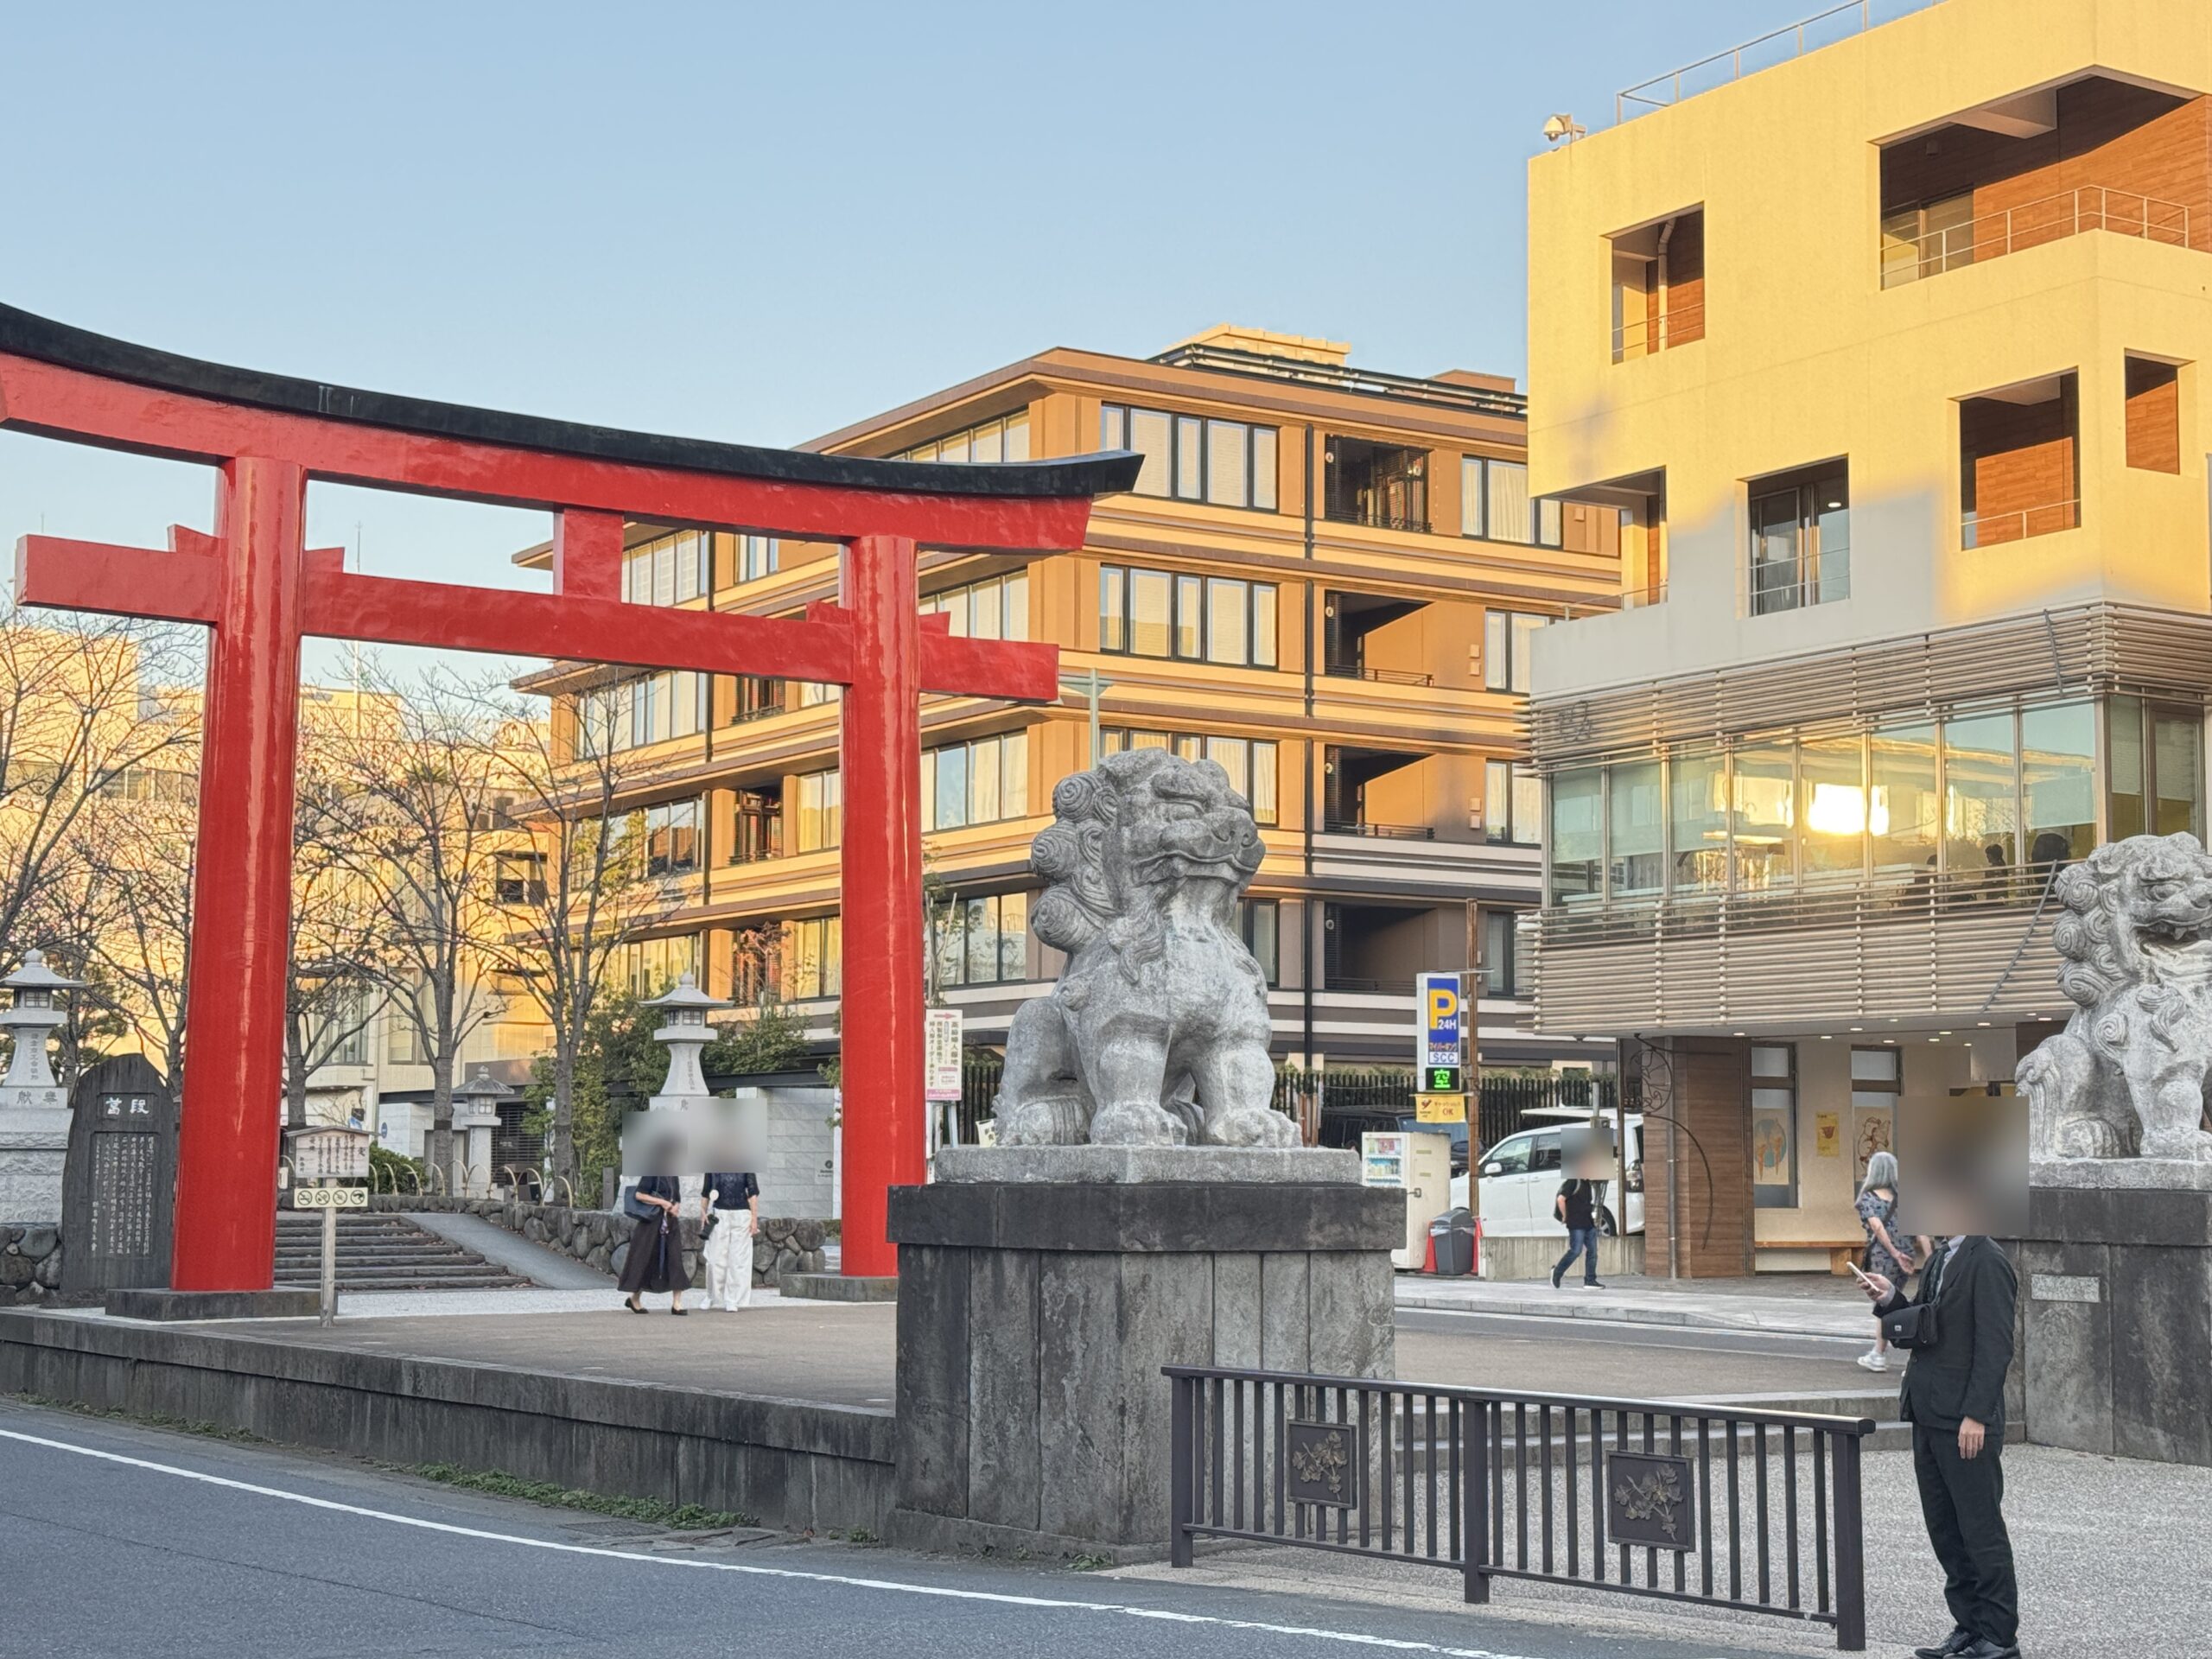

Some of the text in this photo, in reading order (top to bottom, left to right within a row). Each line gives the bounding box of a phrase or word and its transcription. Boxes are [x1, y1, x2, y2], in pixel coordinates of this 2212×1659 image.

[1428, 989, 1457, 1030] P
[1438, 1019, 1457, 1030] 24H
[1433, 1052, 1455, 1063] SCC
[1433, 1069, 1451, 1089] 空
[105, 1096, 149, 1116] 段葛
